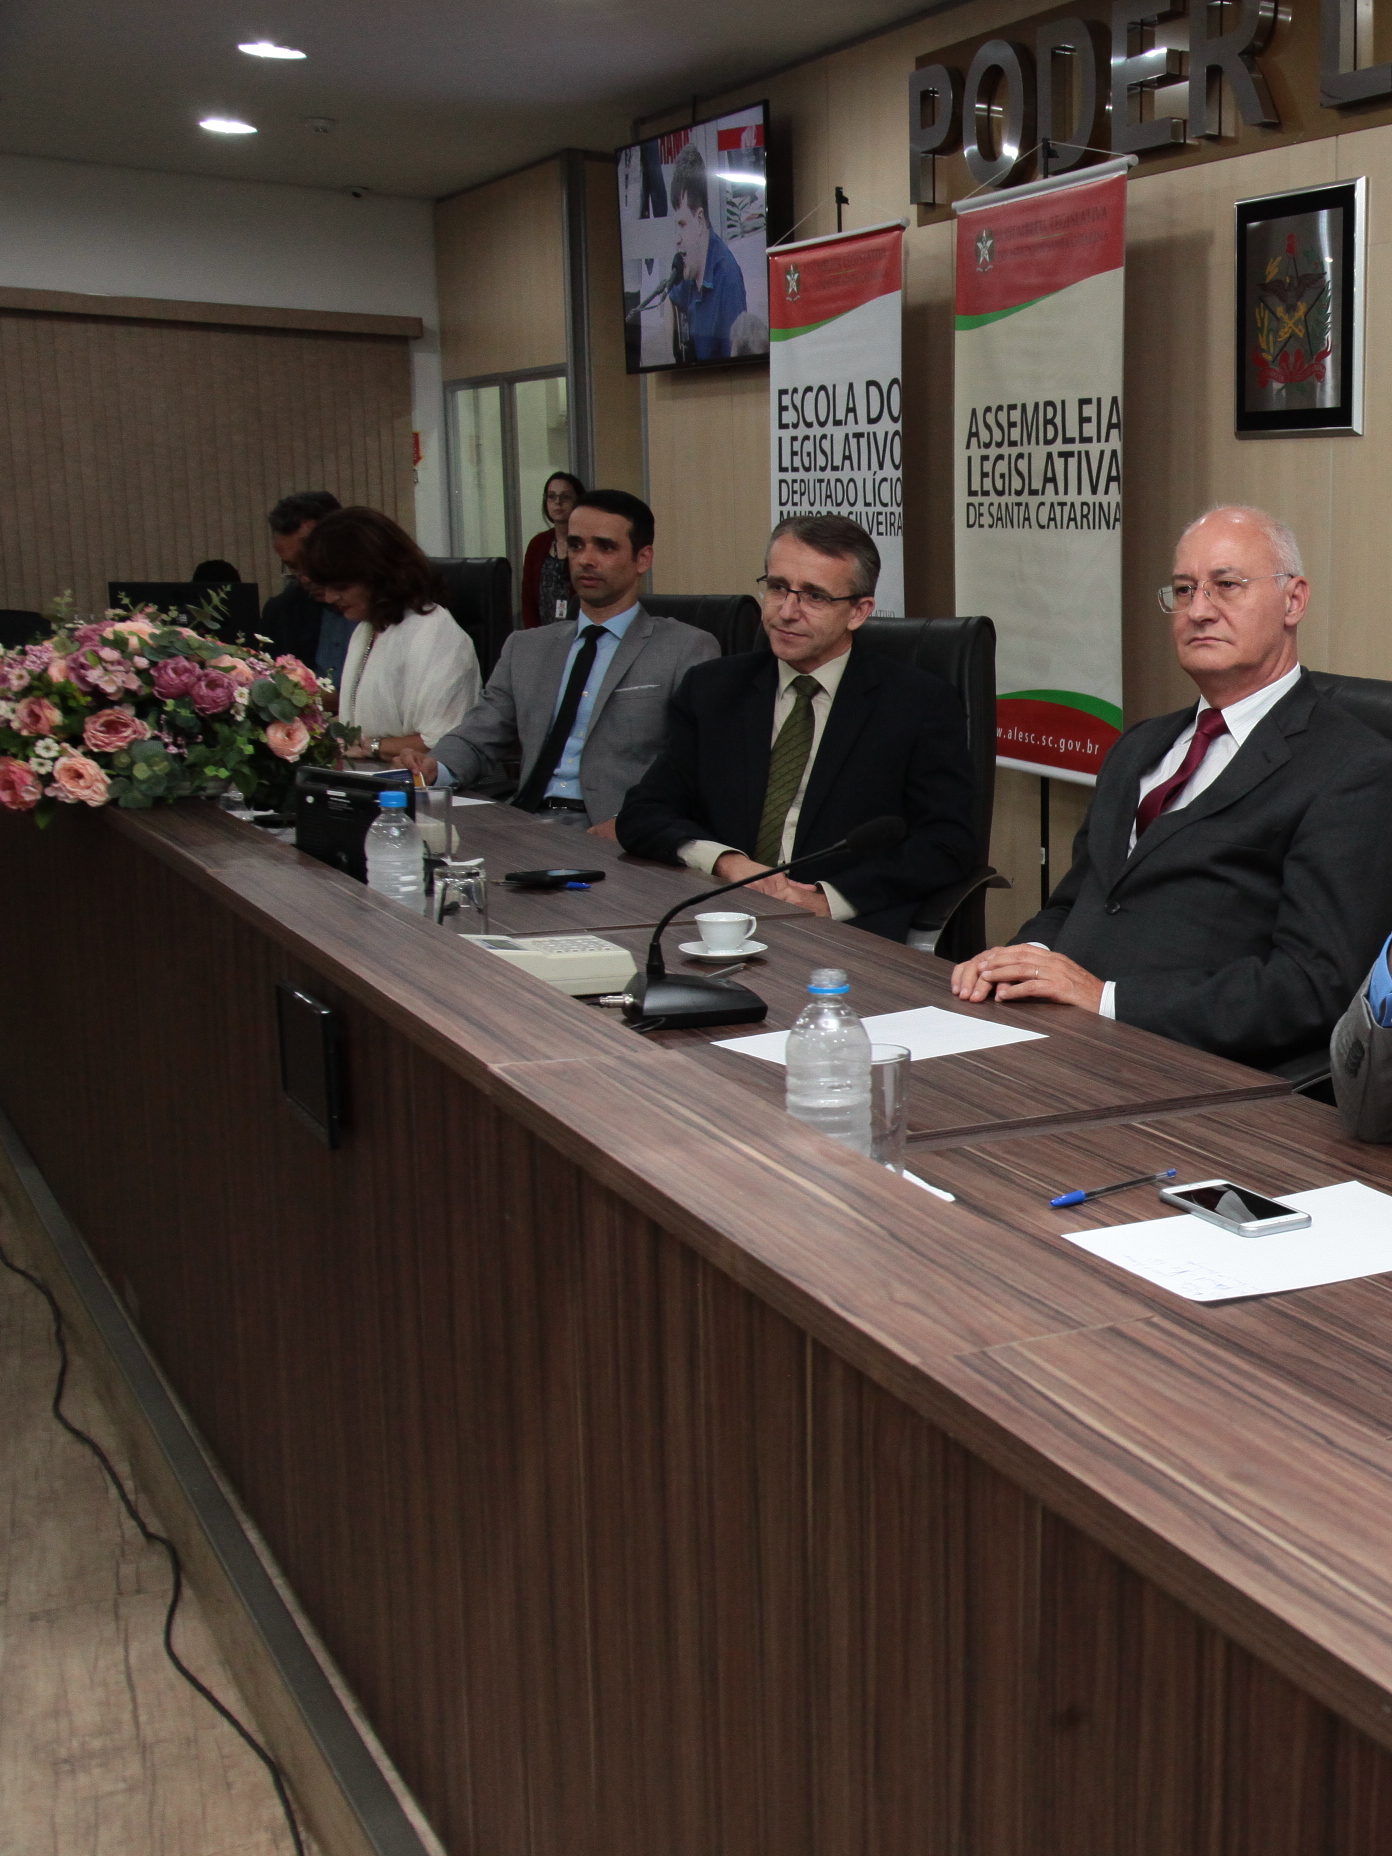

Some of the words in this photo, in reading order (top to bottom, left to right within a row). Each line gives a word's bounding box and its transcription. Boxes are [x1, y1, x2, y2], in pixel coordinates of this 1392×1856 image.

[908, 0, 1288, 206] PODER
[778, 382, 859, 430] ESCOLA
[866, 377, 902, 425] DO
[965, 395, 1122, 450] ASSEMBLEIA
[778, 429, 902, 473] LEGISLATIVO
[967, 448, 1122, 497] LEGISLATIVA
[778, 476, 858, 508] DEPUTADO
[863, 471, 902, 509] LÍCIO
[966, 502, 986, 529] DE
[987, 501, 1032, 530] SANTA
[1035, 500, 1122, 532] CATARINA
